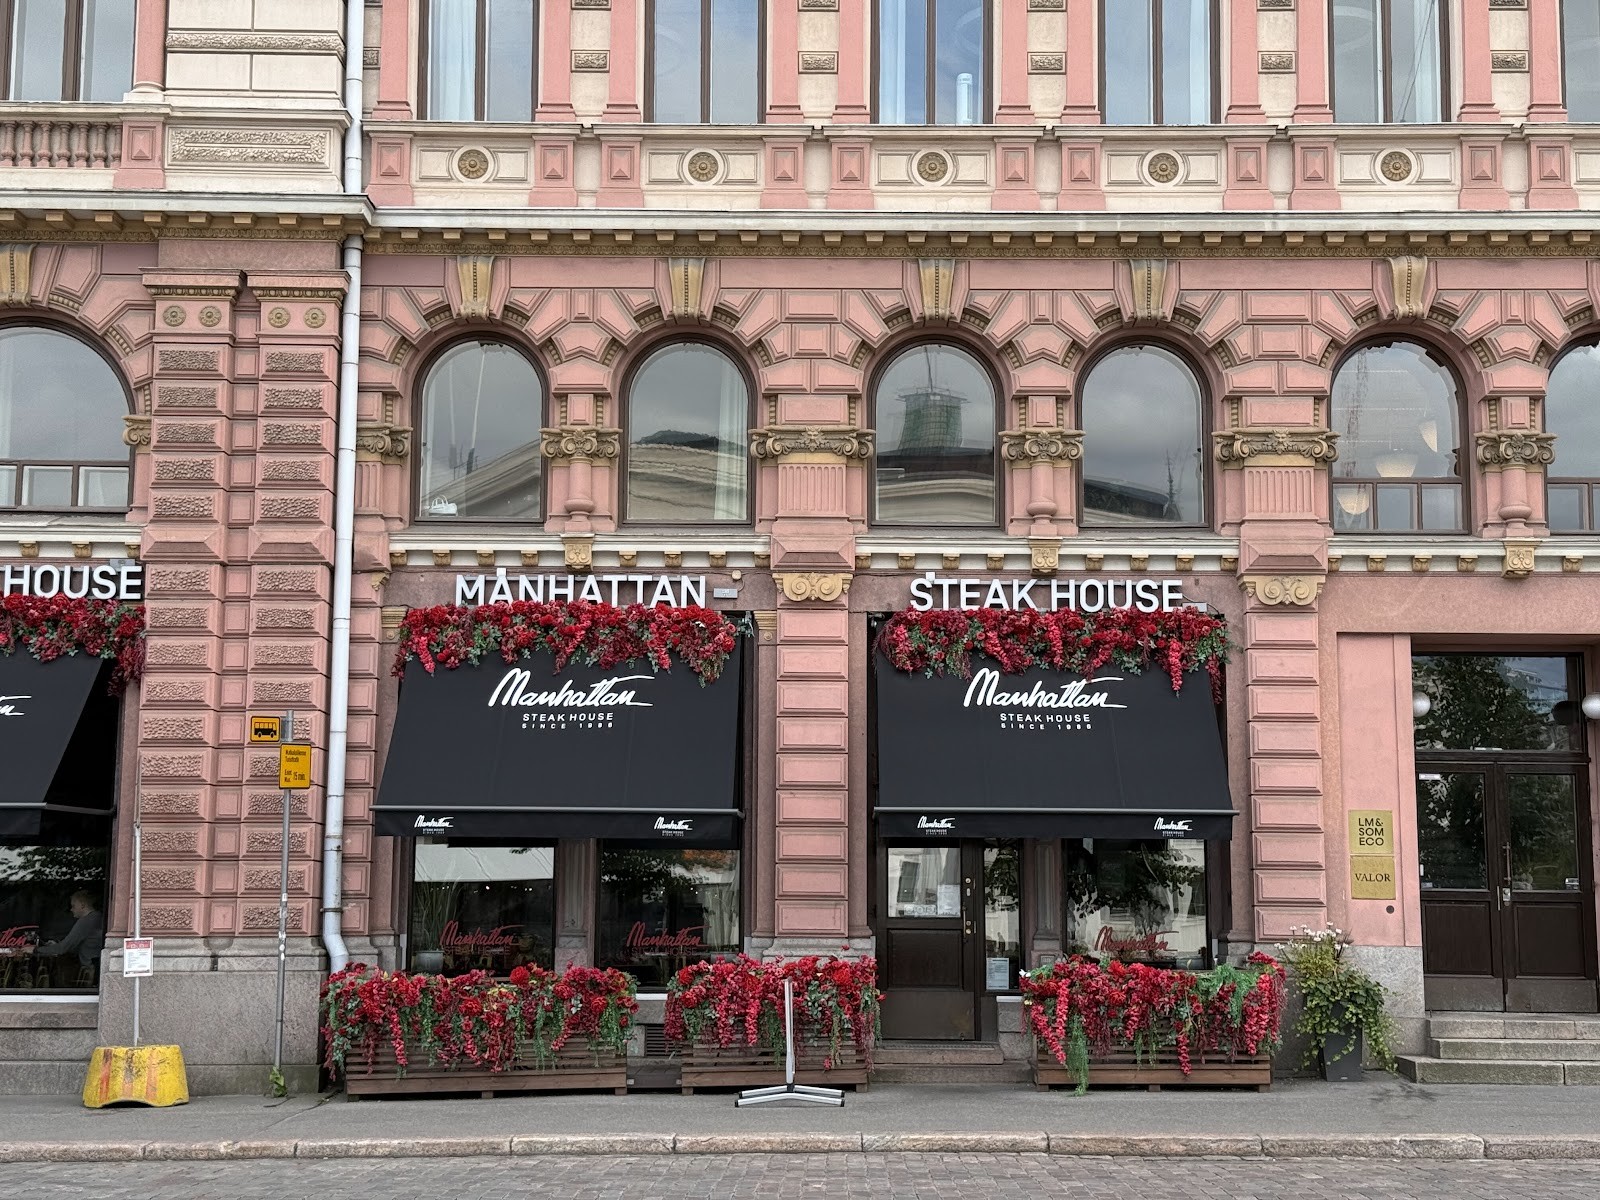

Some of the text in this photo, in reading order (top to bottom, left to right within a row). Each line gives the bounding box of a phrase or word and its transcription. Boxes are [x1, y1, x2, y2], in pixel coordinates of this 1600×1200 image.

[4, 565, 142, 599] HOUSE
[456, 575, 706, 608] MANHATTAN
[910, 578, 1183, 613] STEAK HOUSE
[488, 667, 655, 707] Manhattan
[963, 667, 1128, 709] Manhattan
[522, 712, 614, 722] STEAK HOUSE
[1000, 713, 1091, 723] STEAK HOUSE
[1358, 827, 1385, 836] SOM
[1359, 837, 1385, 846] ECO
[1355, 873, 1391, 882] VALOR
[440, 920, 525, 946] Manhattan
[626, 921, 712, 947] Manhattan
[1093, 925, 1180, 951] Manhattan
